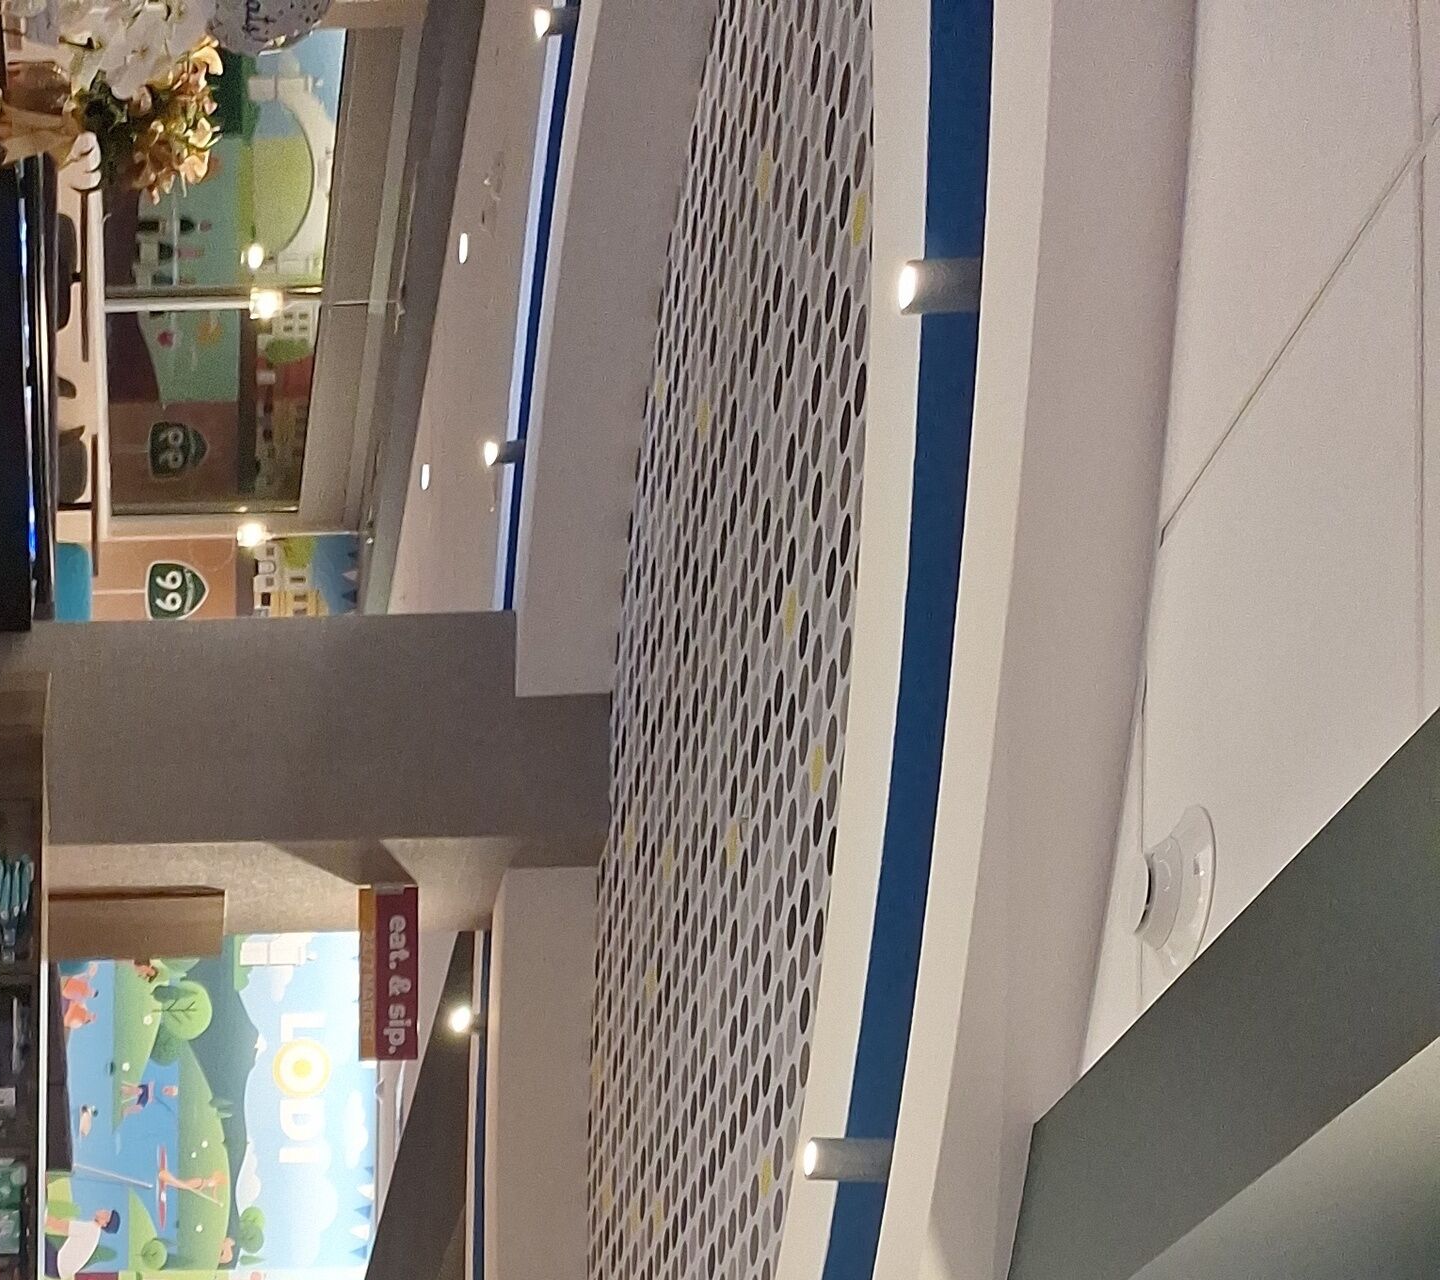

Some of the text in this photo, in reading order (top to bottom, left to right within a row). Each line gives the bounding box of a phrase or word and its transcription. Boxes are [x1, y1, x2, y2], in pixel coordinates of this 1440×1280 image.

[155, 570, 183, 612] 99
[383, 915, 412, 1055] eat. & sip.
[272, 1012, 331, 1164] LODI
